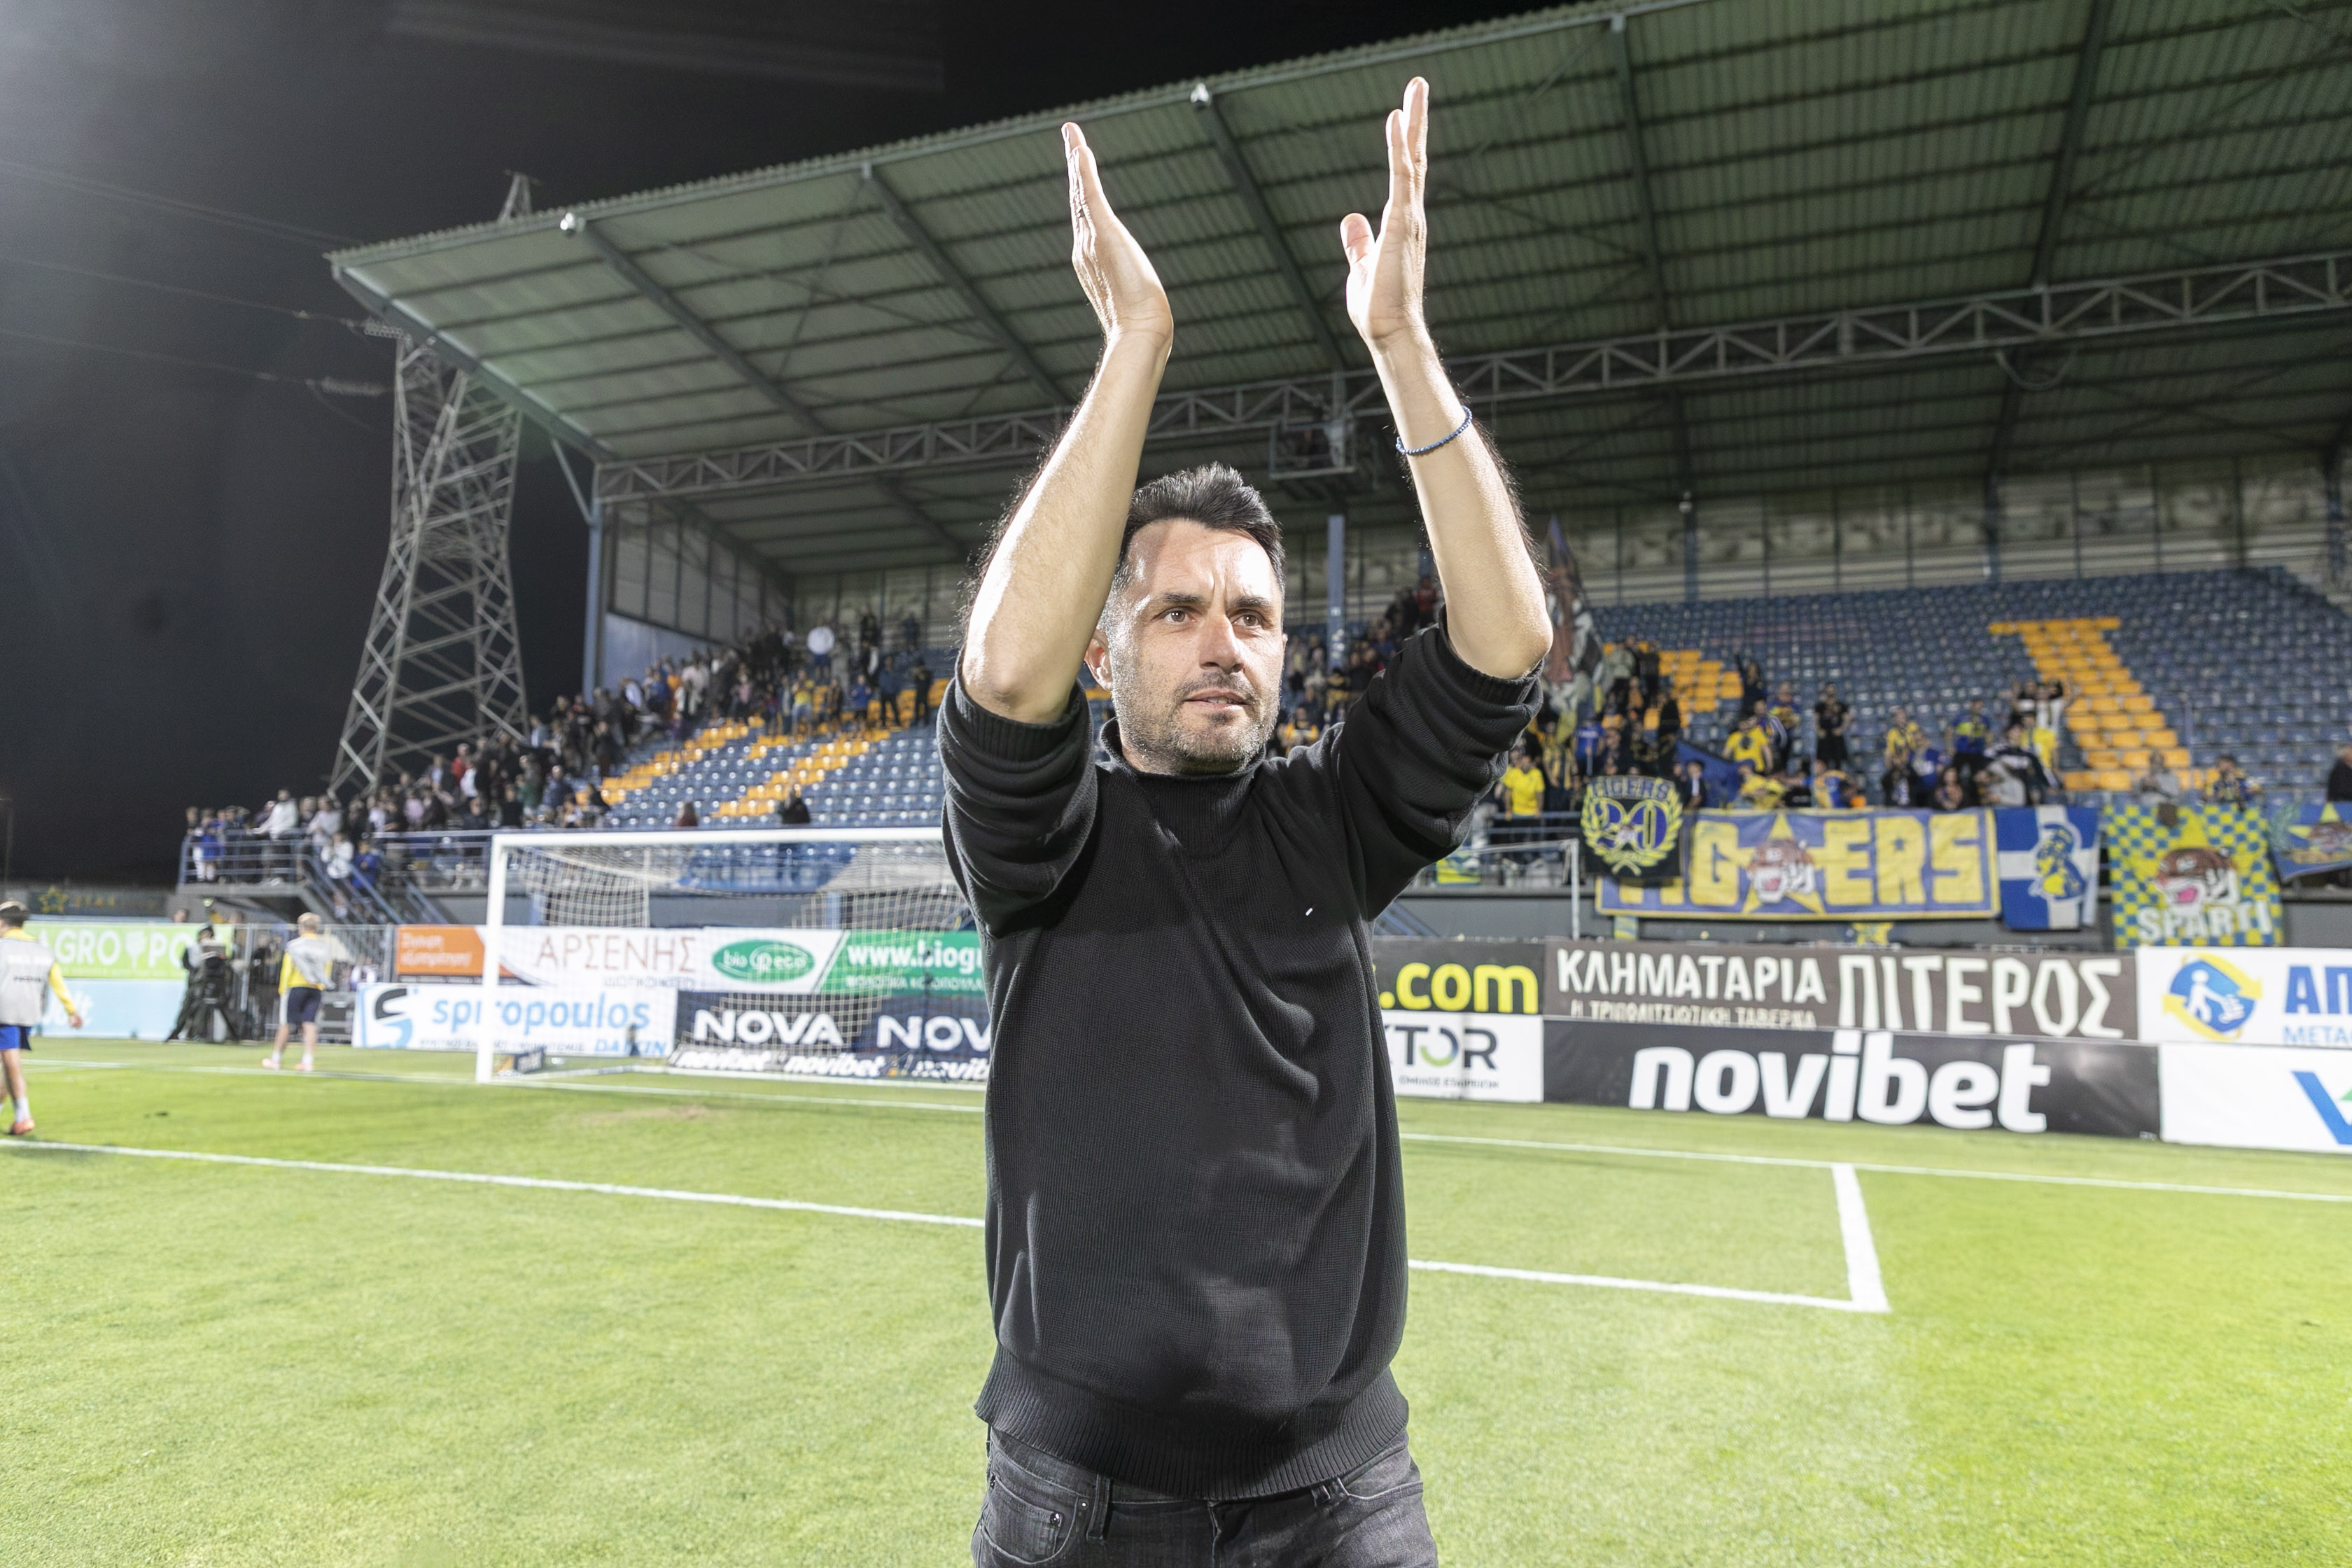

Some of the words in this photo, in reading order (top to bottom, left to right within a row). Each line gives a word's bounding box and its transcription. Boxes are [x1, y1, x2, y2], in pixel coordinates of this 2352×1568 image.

[1590, 776, 1672, 801] TIGERS
[535, 934, 696, 974] ΑΡΣΕΝΗΣ
[1373, 962, 1539, 1014] .com
[1557, 948, 1828, 1004] ΚΛΗΜΑΤΑΡΙΑ
[1838, 954, 2124, 1038] ΠΙΤΕΡΟΣ
[433, 993, 650, 1035] spiopoulos
[693, 1009, 844, 1046] NOVA
[1385, 1025, 1498, 1070] TOR
[2283, 1025, 2352, 1046] ΜΕΤΑ
[783, 1052, 886, 1078] novibet
[1629, 1030, 2052, 1133] novibet
